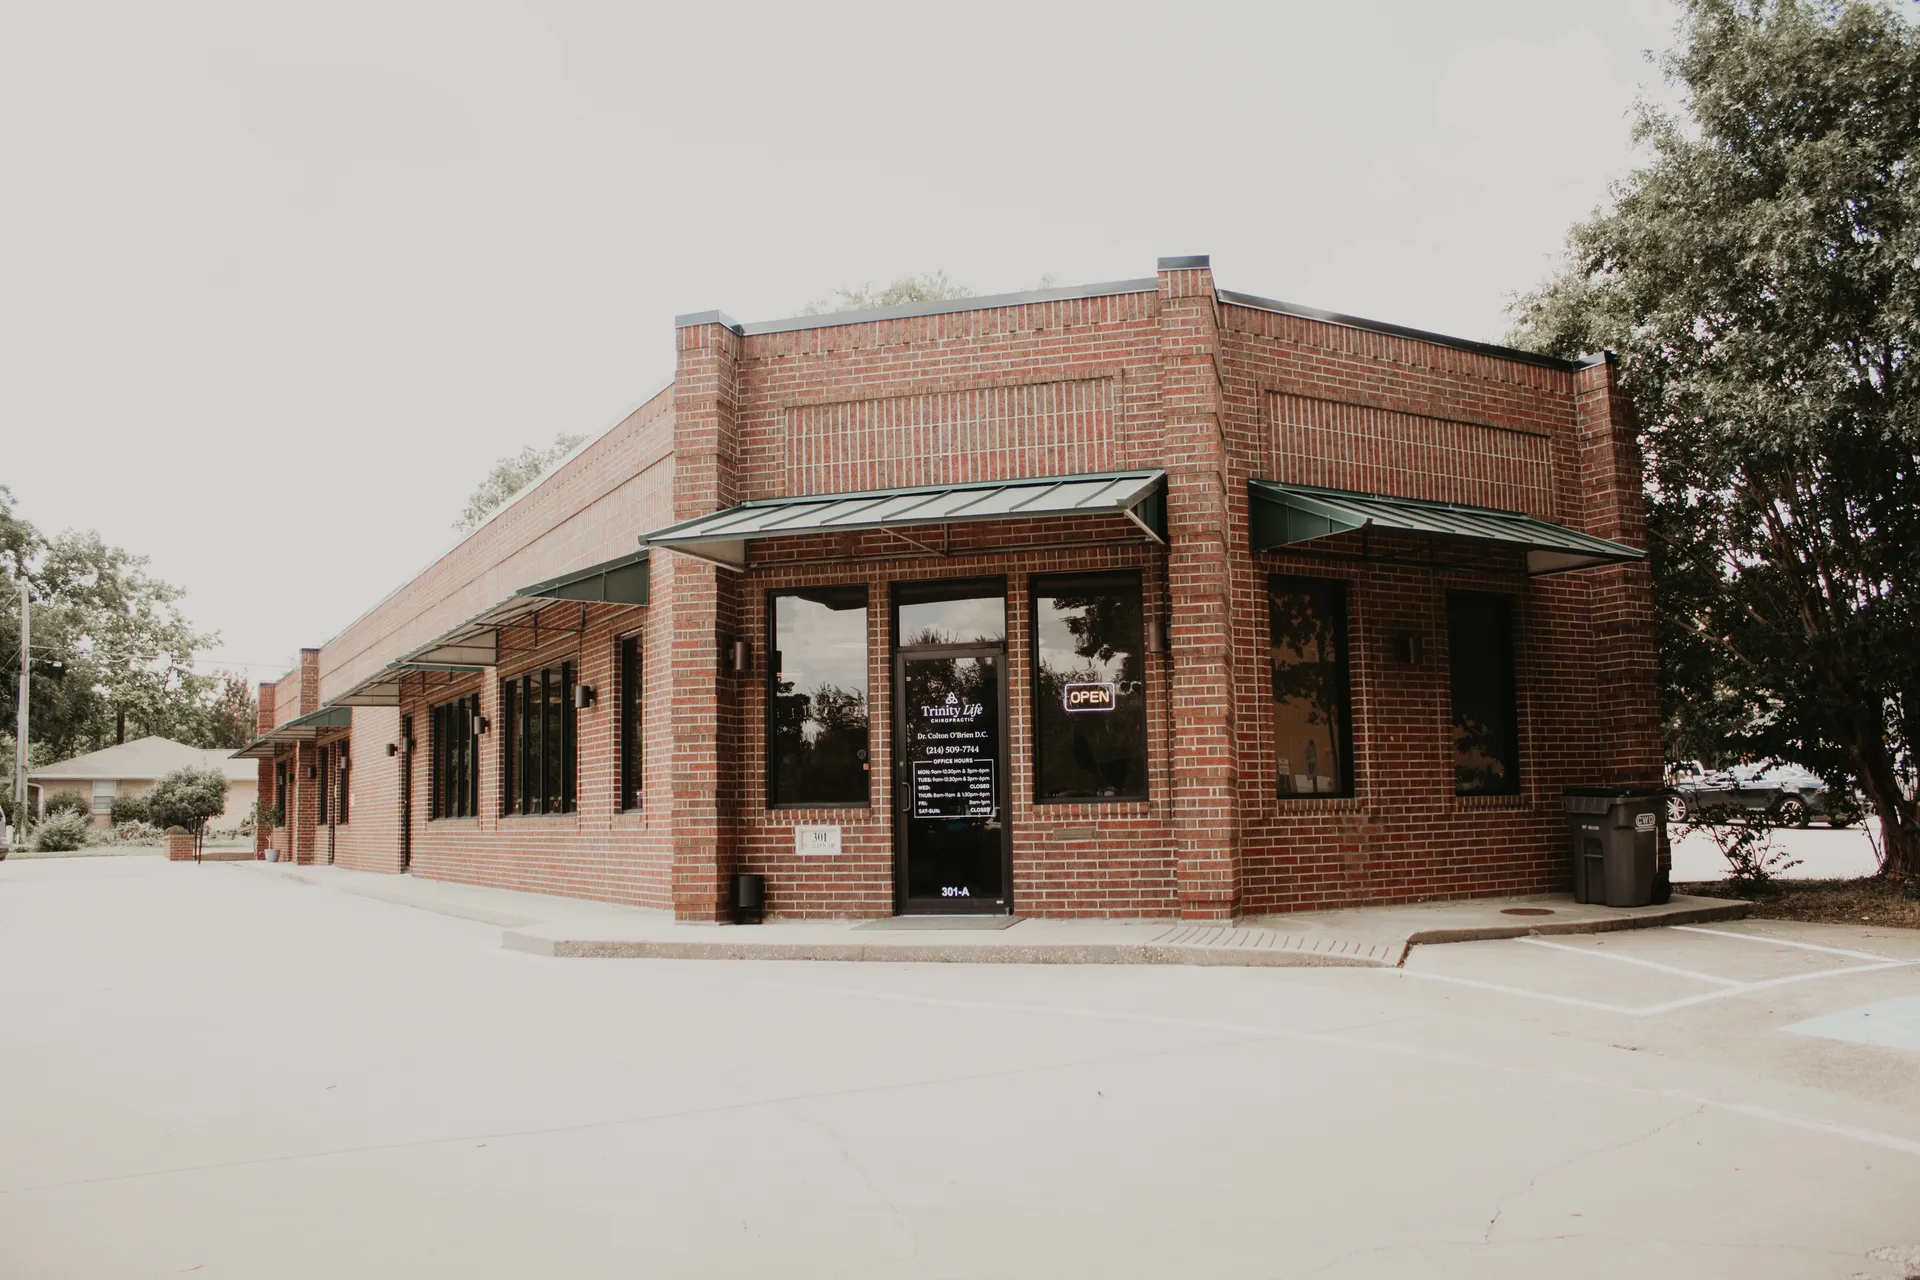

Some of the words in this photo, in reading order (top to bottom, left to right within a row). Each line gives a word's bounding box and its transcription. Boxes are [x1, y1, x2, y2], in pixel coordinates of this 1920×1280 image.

[1070, 691, 1110, 703] OPEN
[921, 705, 961, 718] Trinity
[962, 704, 983, 717] Life
[949, 731, 974, 739] O'Brien
[926, 746, 944, 755] (214)
[945, 745, 979, 754] 509-7744
[1637, 815, 1654, 825] CWD
[812, 832, 827, 843] 301
[942, 887, 970, 896] 301-A
